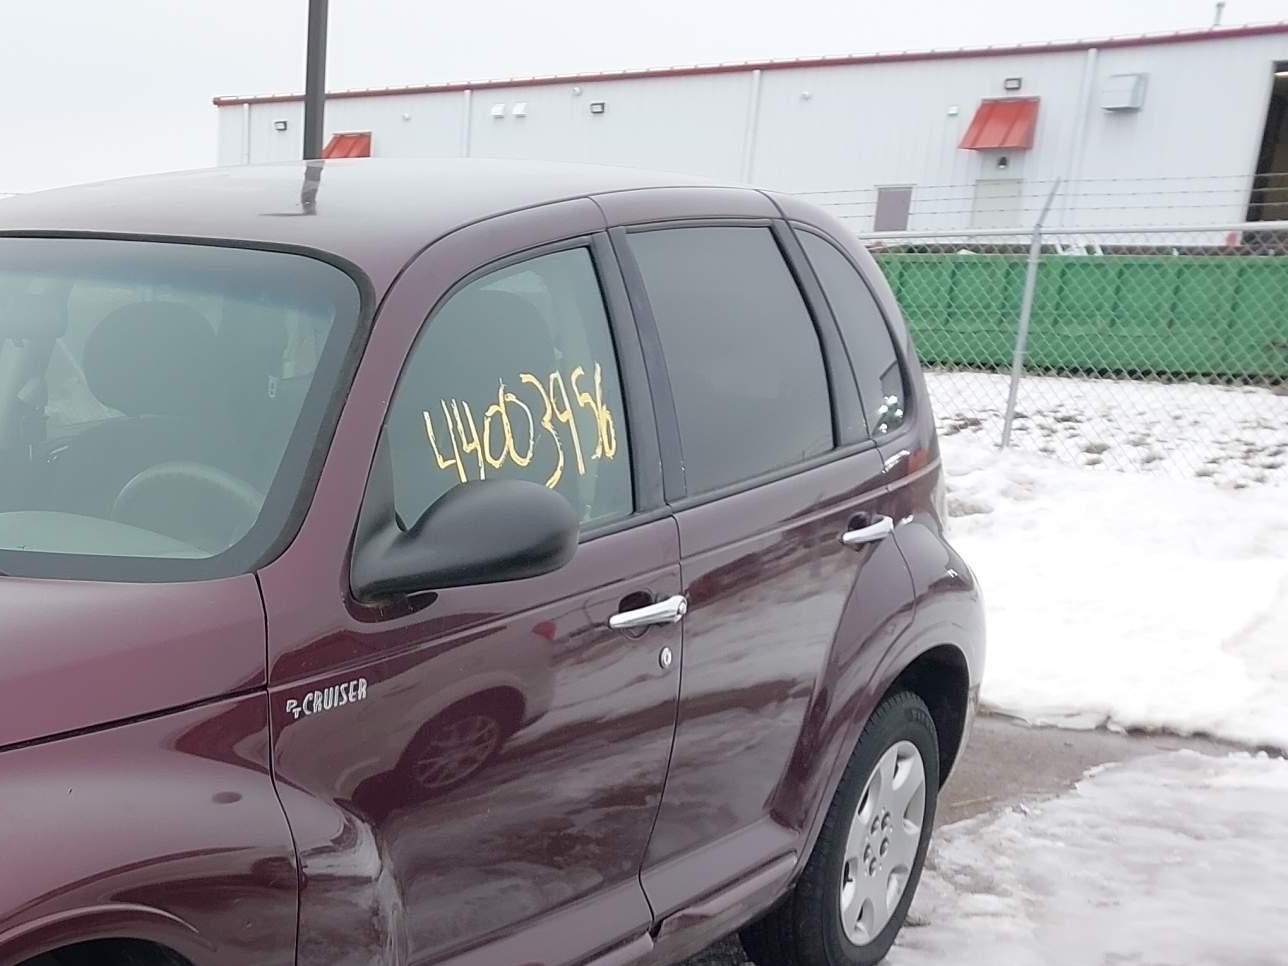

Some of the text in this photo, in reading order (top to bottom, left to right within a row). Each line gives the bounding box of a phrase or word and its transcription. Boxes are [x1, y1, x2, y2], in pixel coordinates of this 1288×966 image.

[424, 362, 616, 489] 44003956
[286, 677, 368, 719] PT CRUISER
